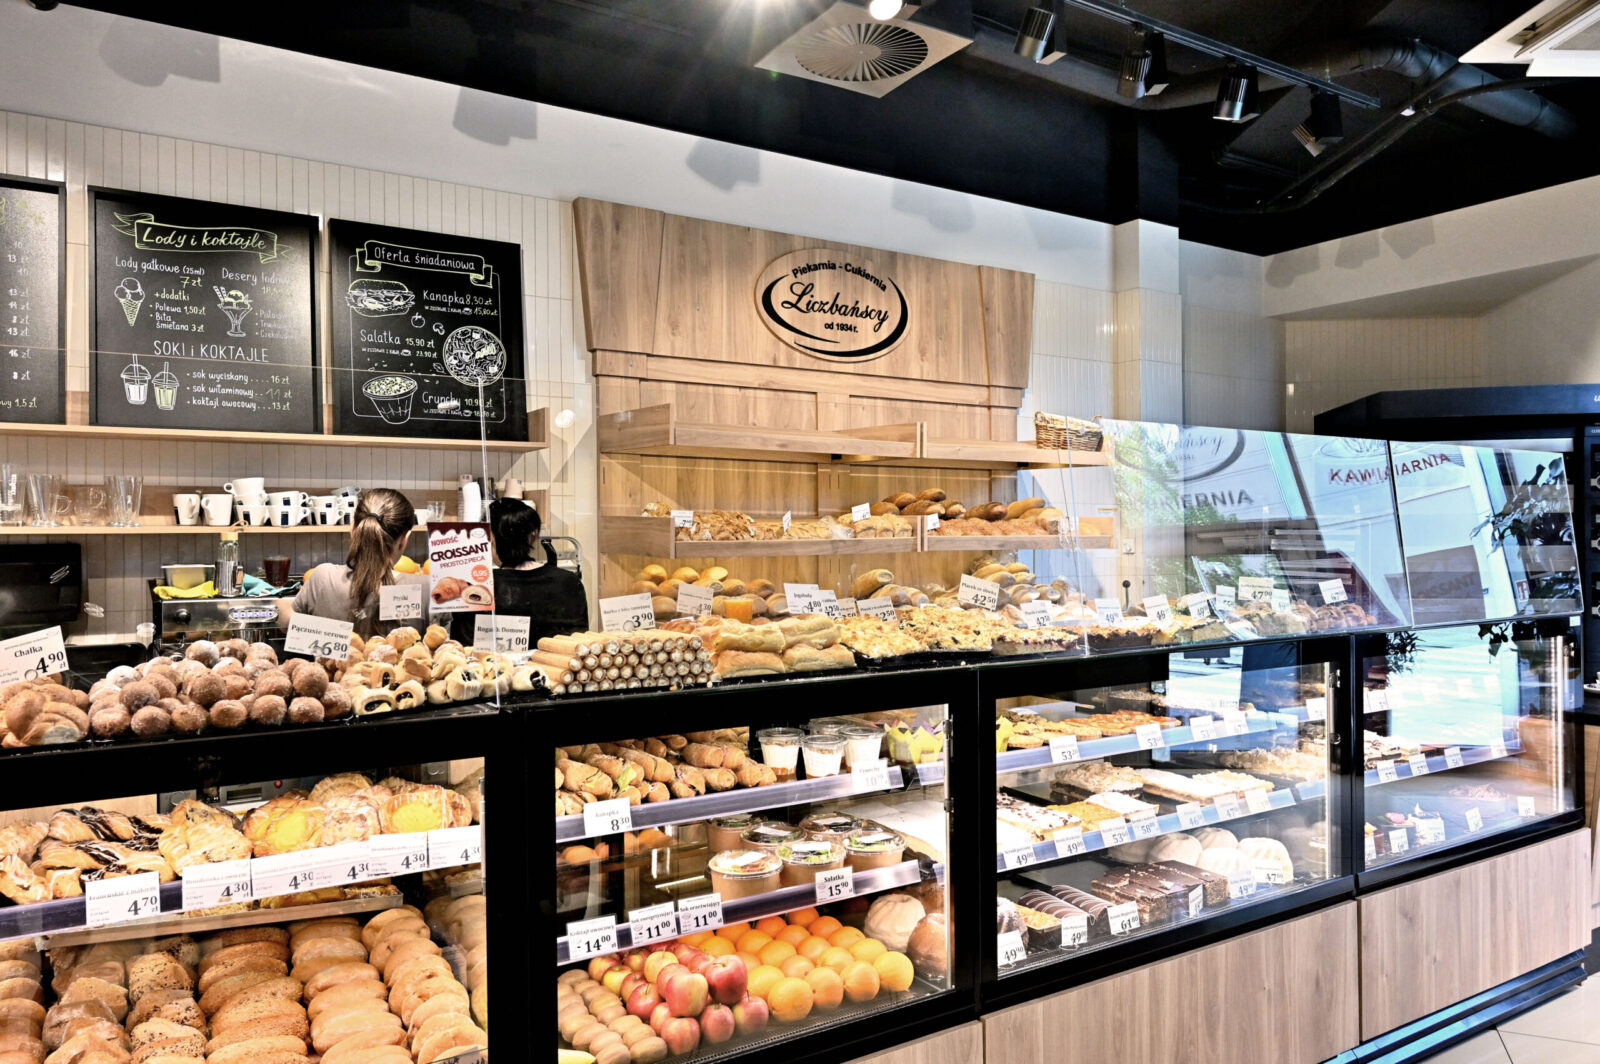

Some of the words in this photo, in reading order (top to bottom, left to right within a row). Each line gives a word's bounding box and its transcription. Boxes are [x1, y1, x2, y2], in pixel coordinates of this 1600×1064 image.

[142, 227, 187, 247] Lody
[191, 234, 197, 246] i
[201, 231, 267, 250] koktajle
[115, 256, 138, 273] Lody
[374, 246, 410, 264] Oferta
[415, 252, 476, 270] śniadaniowa
[180, 276, 190, 288] 7
[222, 267, 258, 286] Desery
[792, 260, 837, 278] Piekarnia
[844, 263, 887, 292] Cukiernia
[423, 290, 465, 307] Kanapka
[155, 302, 182, 313] Polewa
[781, 282, 889, 332] Liczbańscy
[155, 312, 172, 322] Bita
[156, 321, 189, 331] śmietana
[191, 324, 196, 332] 3
[824, 322, 834, 330] od
[154, 340, 185, 356] SOKI
[190, 345, 194, 358] i
[200, 344, 270, 363] KOKTAJLE
[192, 370, 206, 379] sok
[208, 372, 250, 385] wyciskany
[192, 384, 206, 393] sok
[208, 384, 254, 398] witaminowy
[192, 397, 220, 408] koktajl
[222, 400, 257, 412] owocowy
[430, 542, 489, 562] CROISSANT
[440, 558, 464, 568] PROSTO
[14, 646, 43, 658] Chałka
